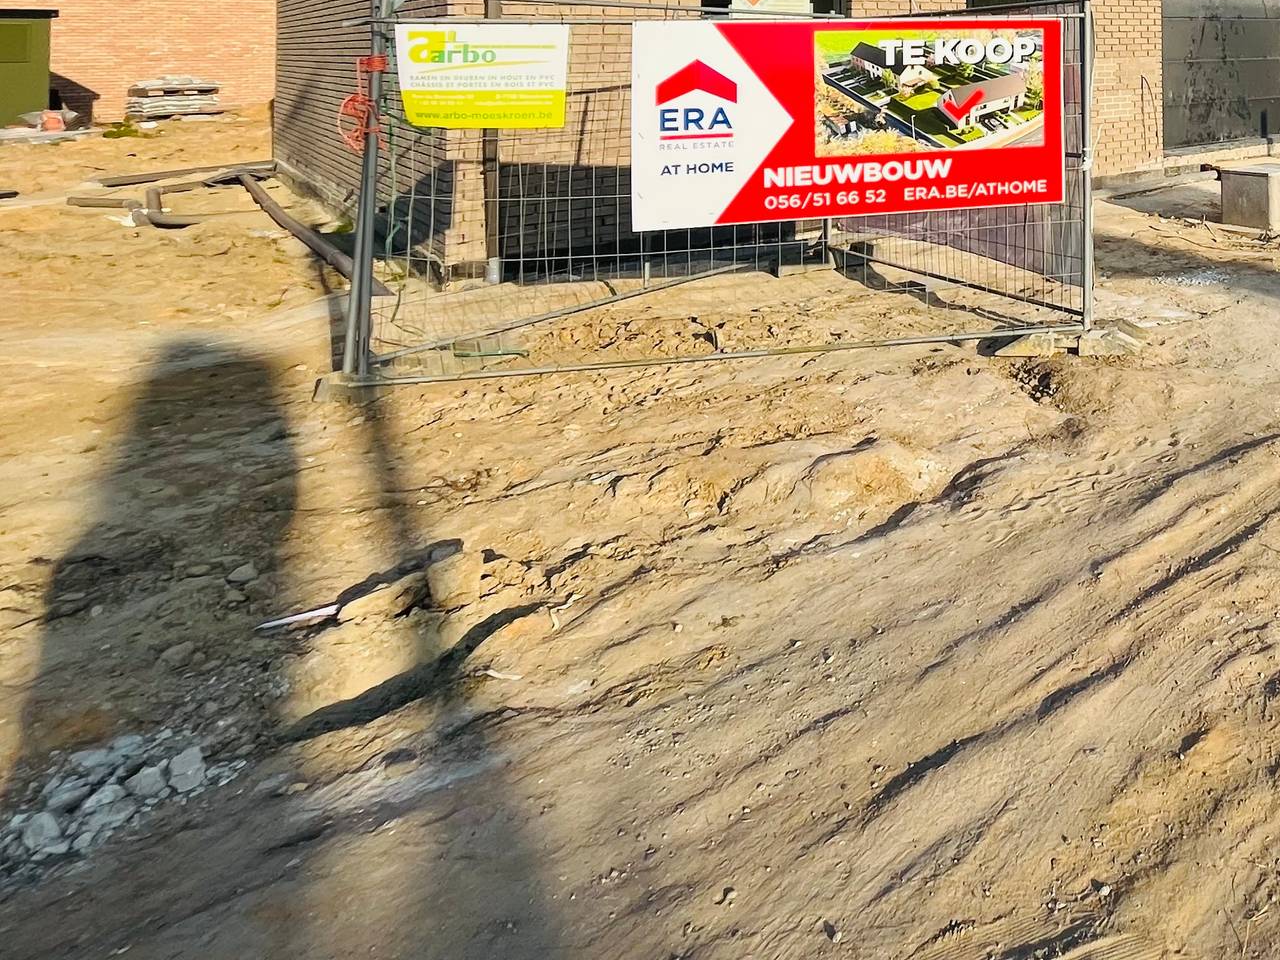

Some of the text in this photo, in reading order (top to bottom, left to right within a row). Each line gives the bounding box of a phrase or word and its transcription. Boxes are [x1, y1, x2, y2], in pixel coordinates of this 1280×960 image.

[879, 36, 1037, 66] TE KOOP
[415, 111, 553, 120] www.arbo-moeskroen.be
[659, 106, 733, 132] ERA
[659, 141, 734, 151] REAL ESTATE
[660, 161, 734, 176] AT HOME
[763, 158, 953, 189] NIEUWBOUW
[764, 179, 1048, 210] 056/51 66 52 ERA.BE/ATHOME
